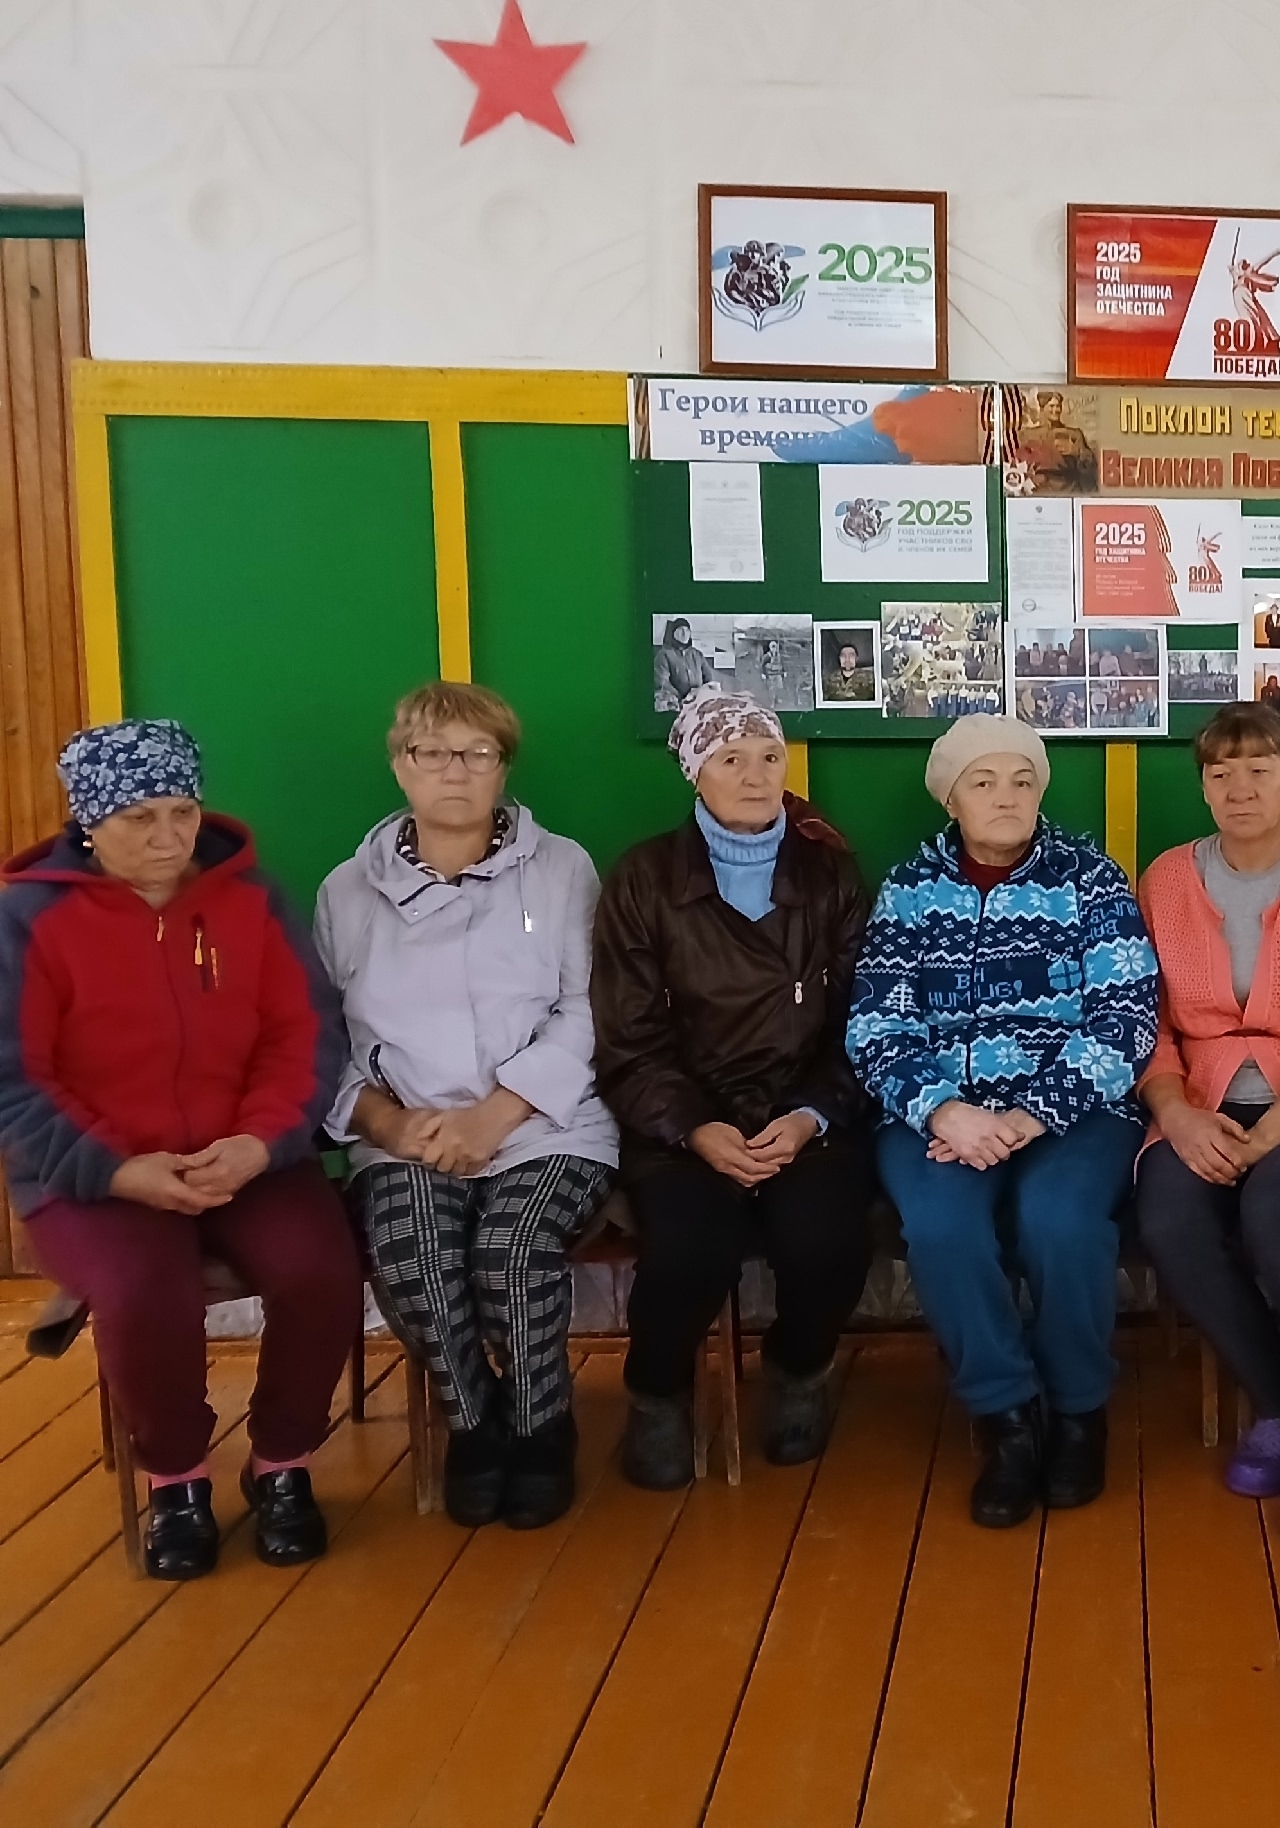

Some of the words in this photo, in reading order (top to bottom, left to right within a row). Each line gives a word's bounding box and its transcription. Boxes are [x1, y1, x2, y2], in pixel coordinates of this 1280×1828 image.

[1096, 241, 1141, 263] 2025
[818, 243, 932, 284] 2025
[1096, 266, 1120, 283] ГОД
[1096, 283, 1172, 300] ЗАЩИТНИКА
[1096, 300, 1165, 316] ОТЕЧЕСТВА
[1214, 318, 1250, 353] 80
[658, 388, 749, 419] Герои
[700, 429, 832, 453] времен
[897, 500, 973, 525] 2025
[1095, 523, 1146, 545] 2025
[1189, 566, 1208, 582] 80
[1189, 583, 1222, 593] ПОБЕДА!
